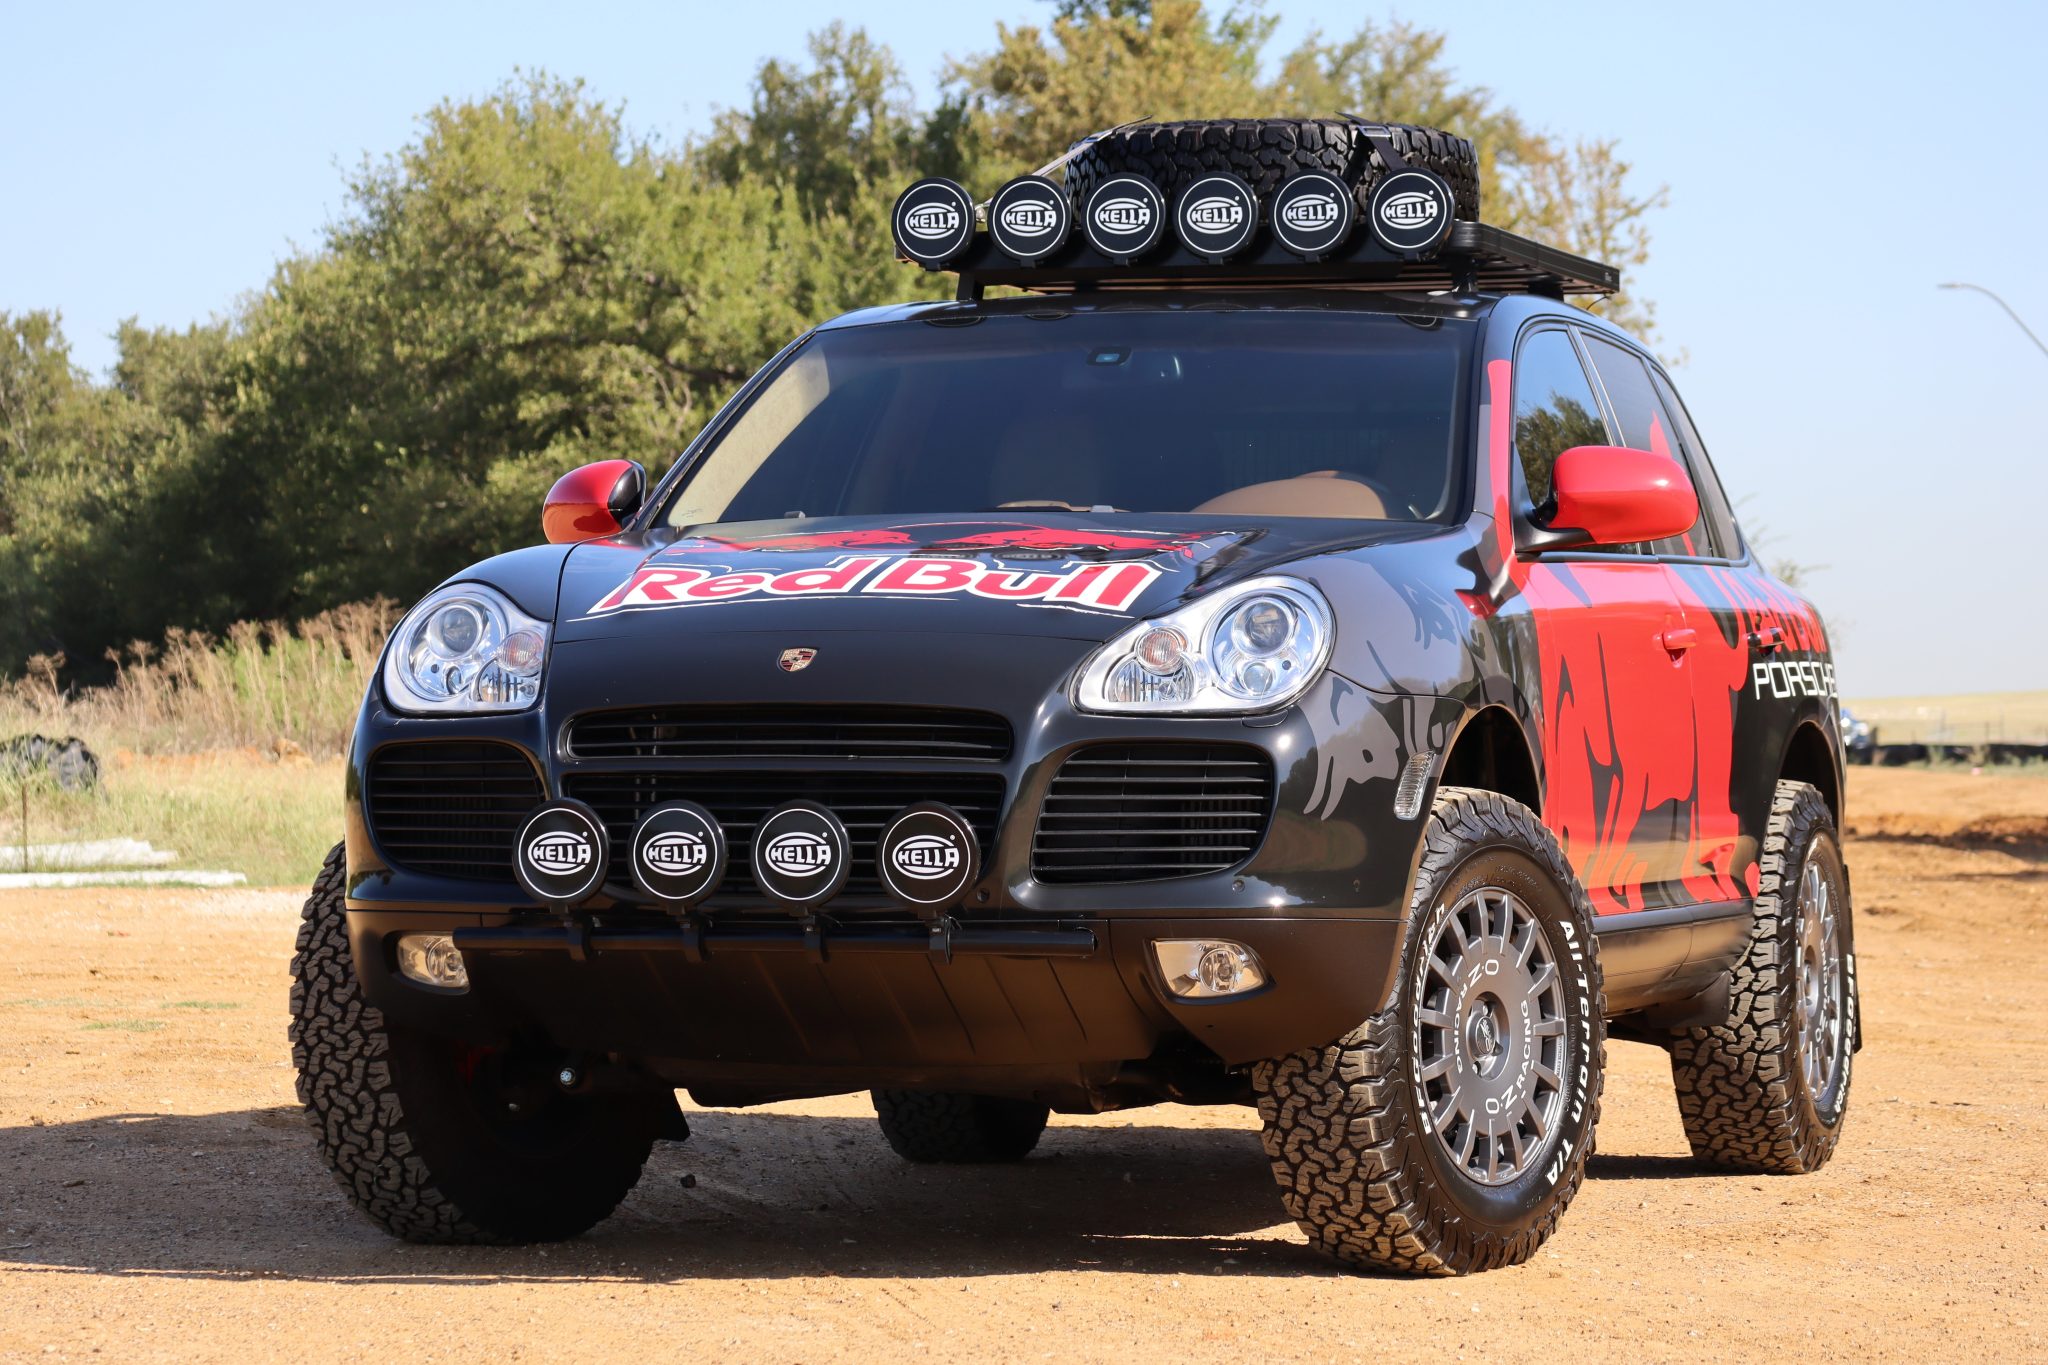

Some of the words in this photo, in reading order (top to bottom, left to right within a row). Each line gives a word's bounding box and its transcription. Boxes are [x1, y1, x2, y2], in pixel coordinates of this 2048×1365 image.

[1005, 210, 1056, 228] HELLA
[1099, 208, 1150, 225] HELLA
[1191, 206, 1243, 223] HELLA
[1286, 203, 1338, 221] HELLA
[1385, 200, 1438, 218] HELLA
[909, 212, 959, 229] HELLA
[588, 557, 888, 613] Red
[863, 558, 1161, 611] Bull
[1752, 662, 1838, 700] PORSCHE
[533, 844, 591, 864] HELLA
[648, 844, 707, 864] HELLA
[770, 845, 831, 865] HELLA
[897, 848, 959, 867] HELLA
[1454, 982, 1468, 1074] RACING
[1559, 921, 1590, 1124] All-Terrain
[1516, 1000, 1531, 1089] RACING
[1546, 1138, 1573, 1186] T/A
